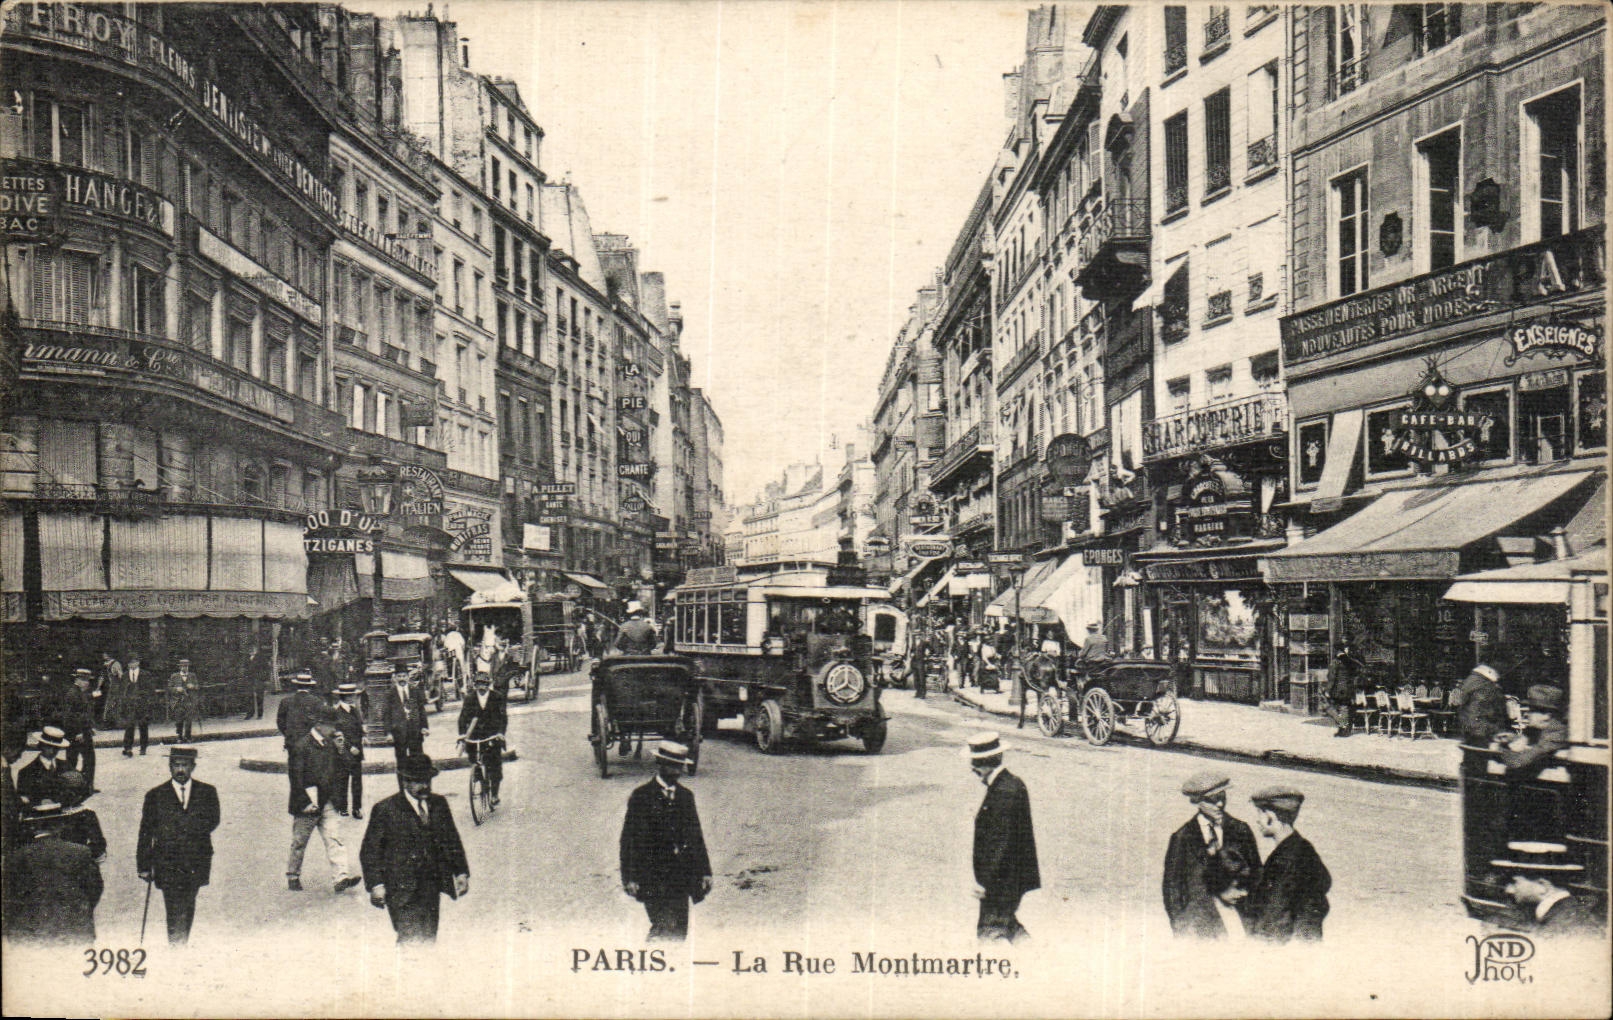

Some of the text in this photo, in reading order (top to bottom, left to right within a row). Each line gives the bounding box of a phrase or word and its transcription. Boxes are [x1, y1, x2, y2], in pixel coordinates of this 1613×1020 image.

[124, 355, 139, 369] &
[625, 363, 640, 376] LA
[622, 397, 645, 410] PIE
[626, 431, 641, 443] QUI
[619, 464, 649, 476] CHANTE
[400, 502, 441, 515] ITALIEN
[303, 539, 374, 553] TZIGANES
